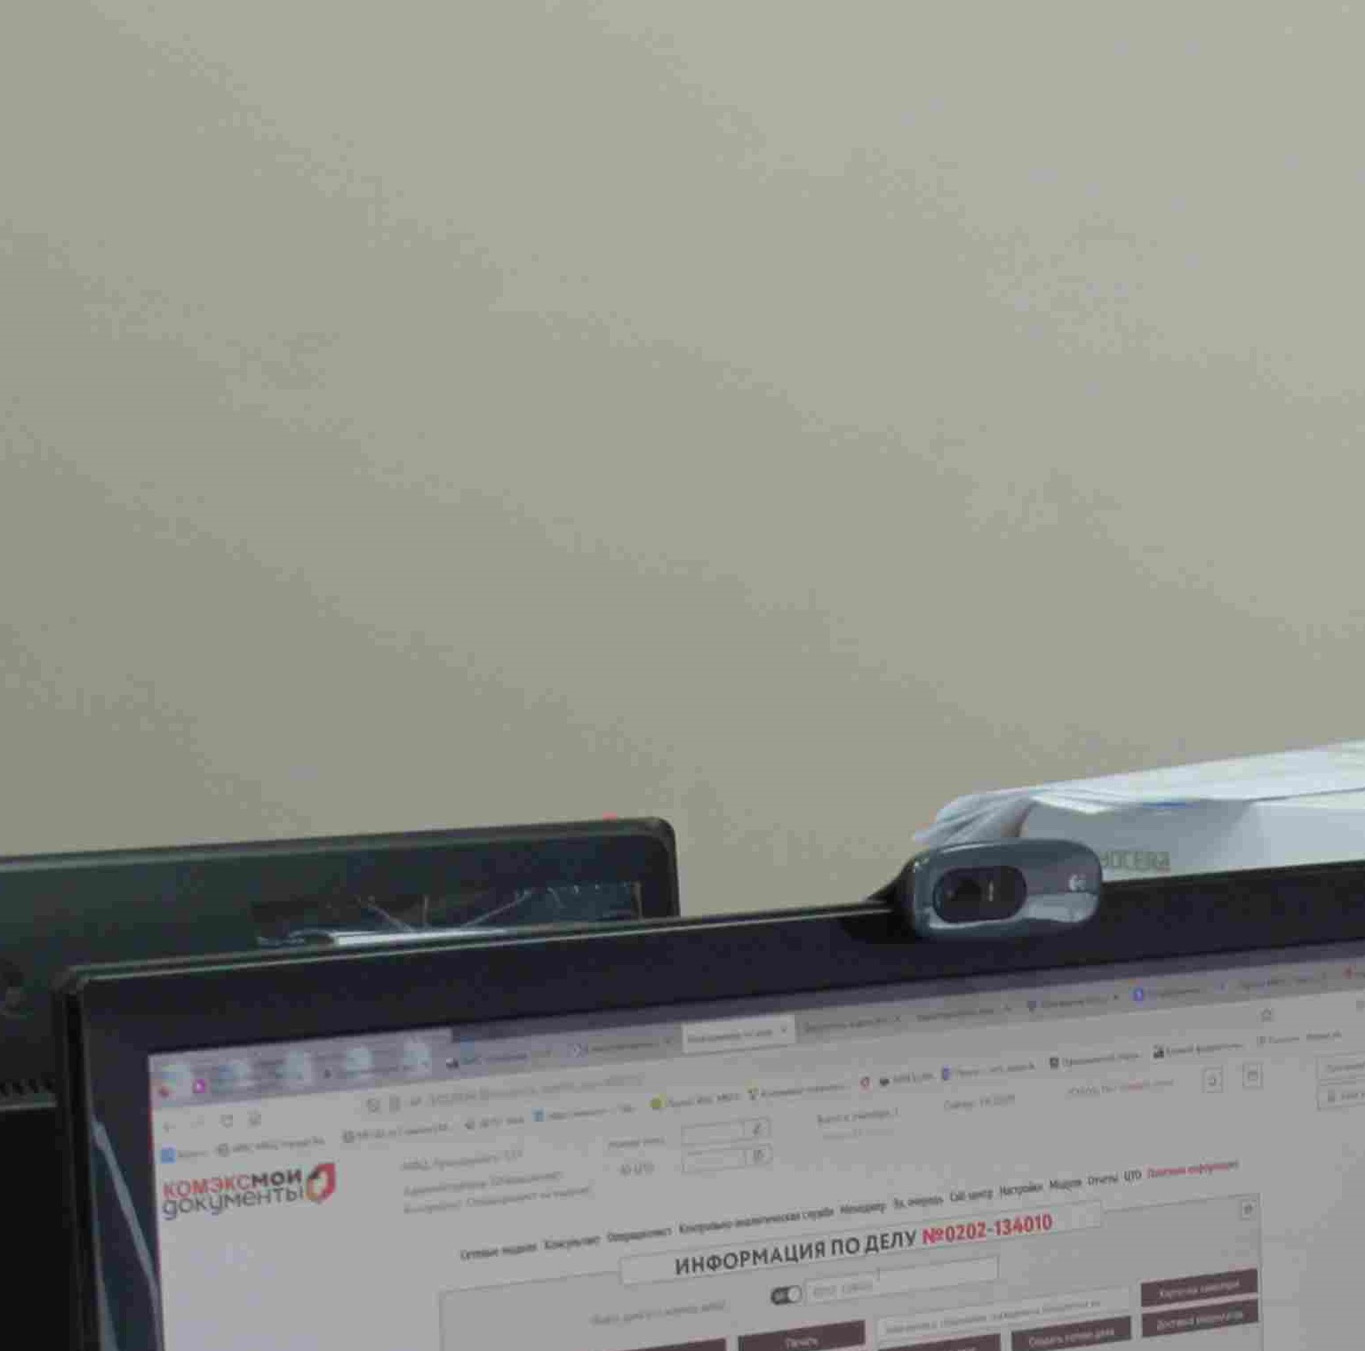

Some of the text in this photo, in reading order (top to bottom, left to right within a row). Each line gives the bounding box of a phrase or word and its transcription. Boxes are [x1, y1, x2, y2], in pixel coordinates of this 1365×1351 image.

[1100, 849, 1170, 871] YOCERA
[163, 1184, 304, 1220] документы
[675, 1212, 1053, 1276] ИНФОРМАЦИЯ ПО ДЕЛУ №0202-134010
